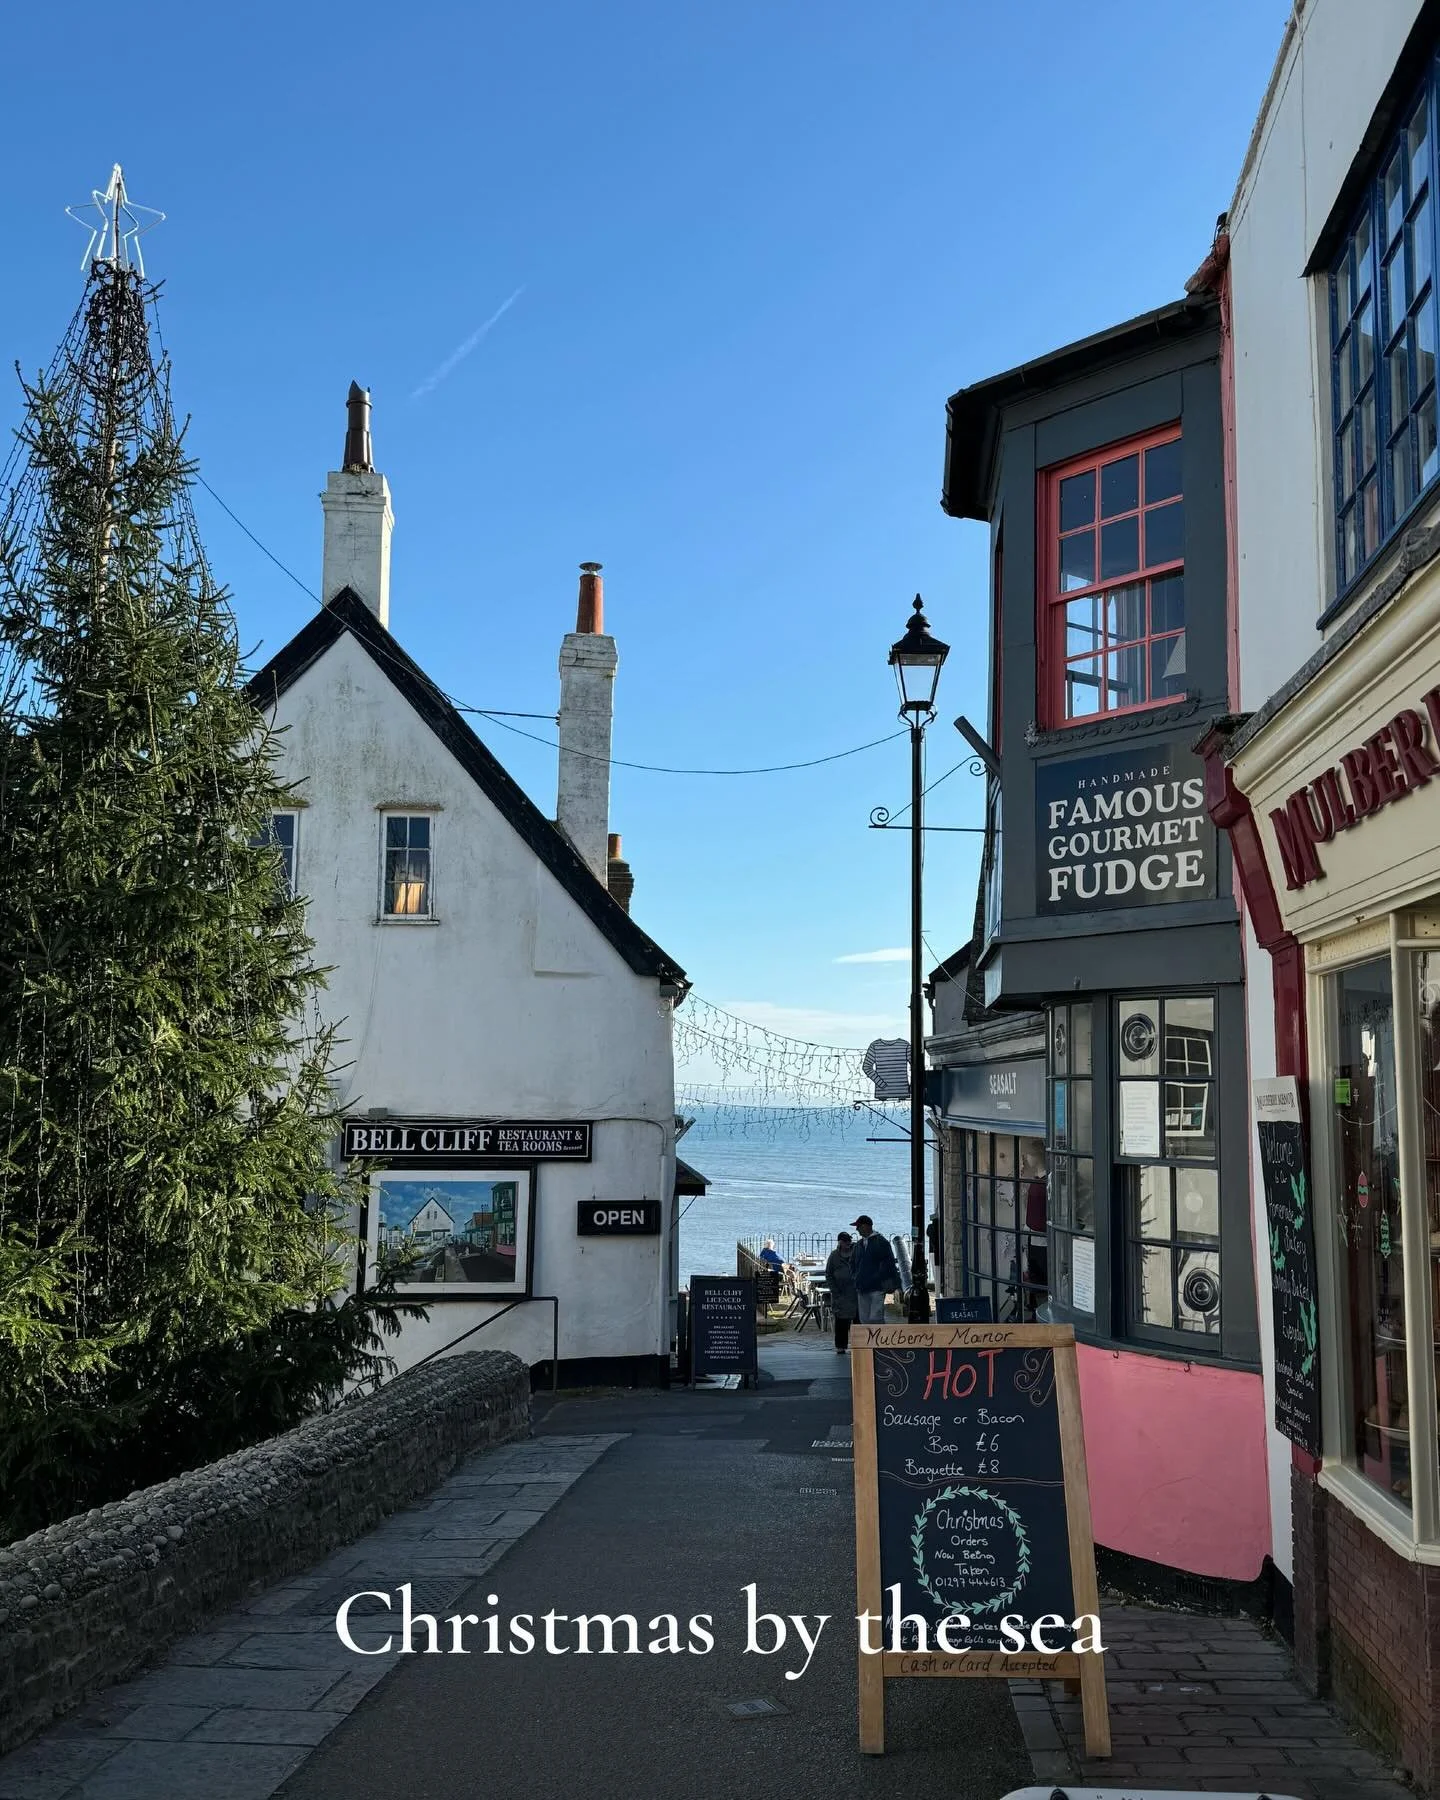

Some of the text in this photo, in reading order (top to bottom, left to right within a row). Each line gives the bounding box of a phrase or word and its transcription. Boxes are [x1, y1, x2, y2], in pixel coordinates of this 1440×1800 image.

[1078, 765, 1171, 789] HANDMADE
[1048, 778, 1204, 829] FAMOUS
[1048, 815, 1204, 860] GOURMET
[1048, 849, 1205, 902] FUDGE
[989, 1072, 1017, 1095] SEASALT
[351, 1128, 493, 1151] BELL CLIFF
[497, 1140, 562, 1152] TEA ROOMS
[498, 1129, 583, 1141] RESTAURANT &
[593, 1210, 645, 1226] OPEN
[951, 1310, 979, 1319] SEASALT
[866, 1327, 1014, 1346] Mulberry Manor
[883, 1404, 1025, 1434] Sausage or Bacon
[924, 1432, 1000, 1455] Bap £6
[904, 1457, 1000, 1482] Baguette £8
[936, 1508, 1004, 1531] Christmas
[951, 1534, 989, 1546] Orders
[935, 1549, 995, 1565] Now Being
[954, 1562, 990, 1576] Taken
[900, 1652, 1058, 1674] Cash or Card Accepted
